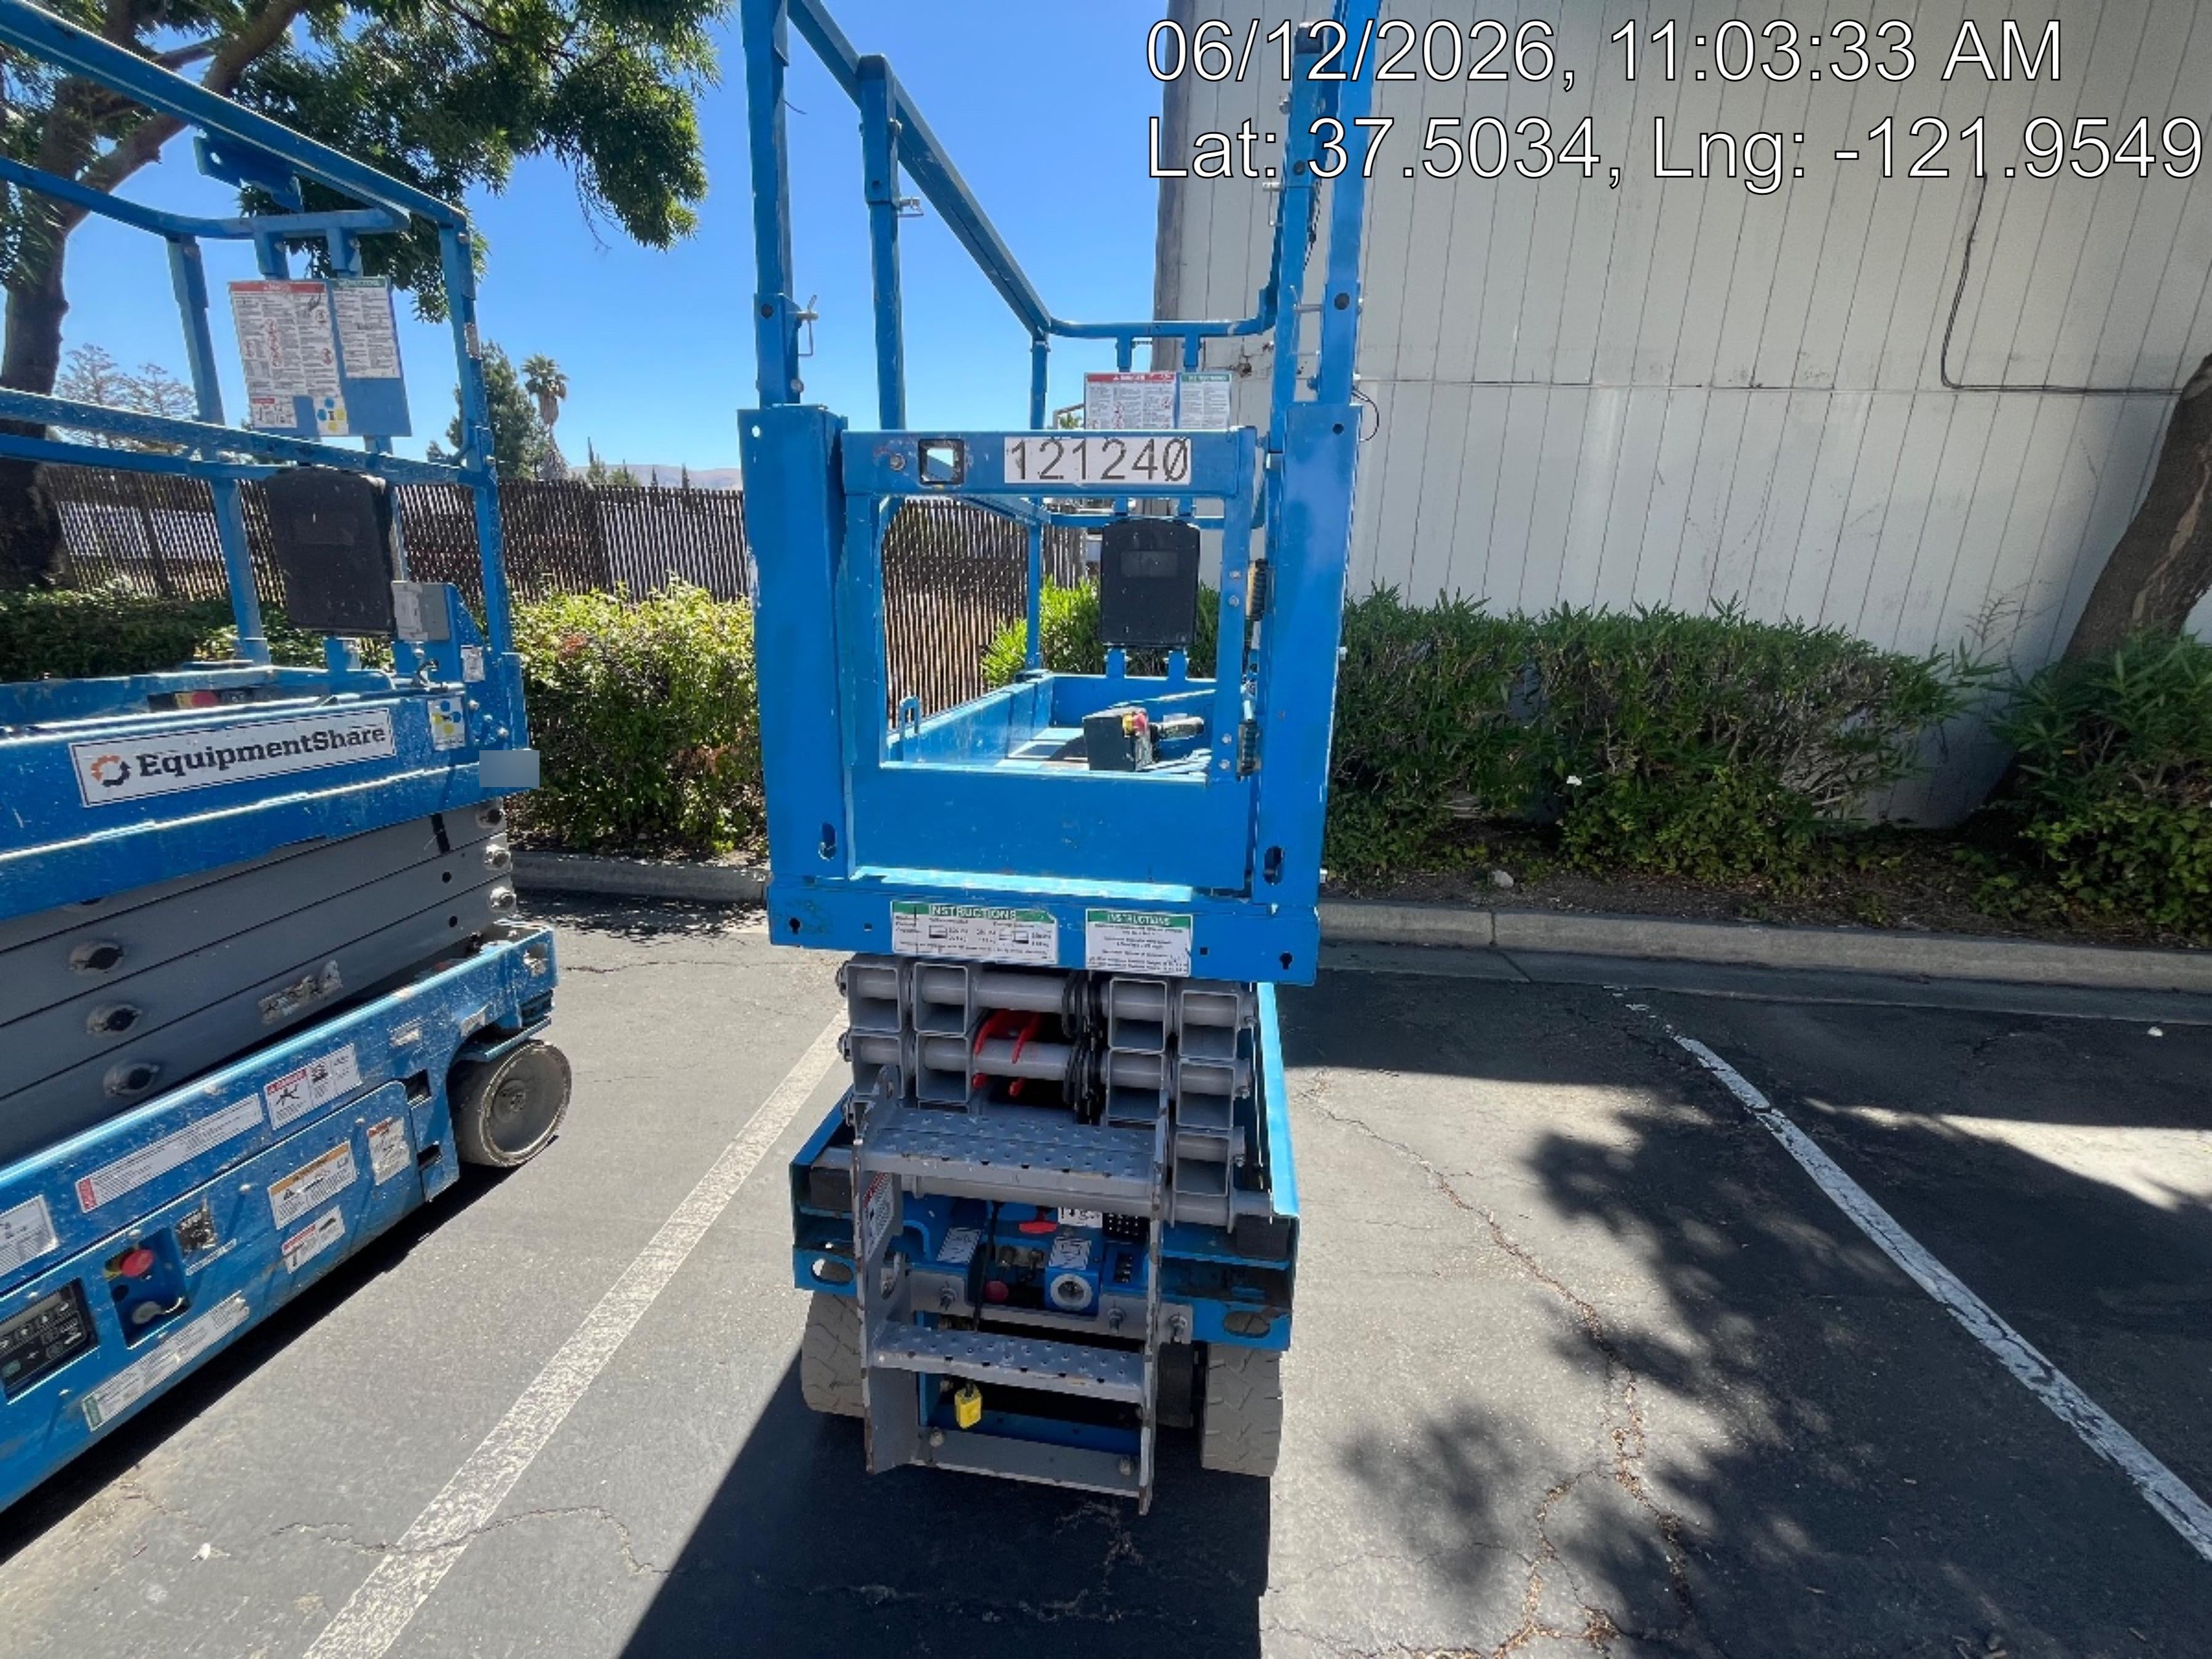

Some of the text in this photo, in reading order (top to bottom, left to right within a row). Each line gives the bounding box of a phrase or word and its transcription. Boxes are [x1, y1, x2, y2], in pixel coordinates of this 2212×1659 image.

[1011, 437, 1189, 482] 121240
[136, 726, 386, 778] EquipmentShare
[929, 904, 1016, 920] INSTRUCTIONS
